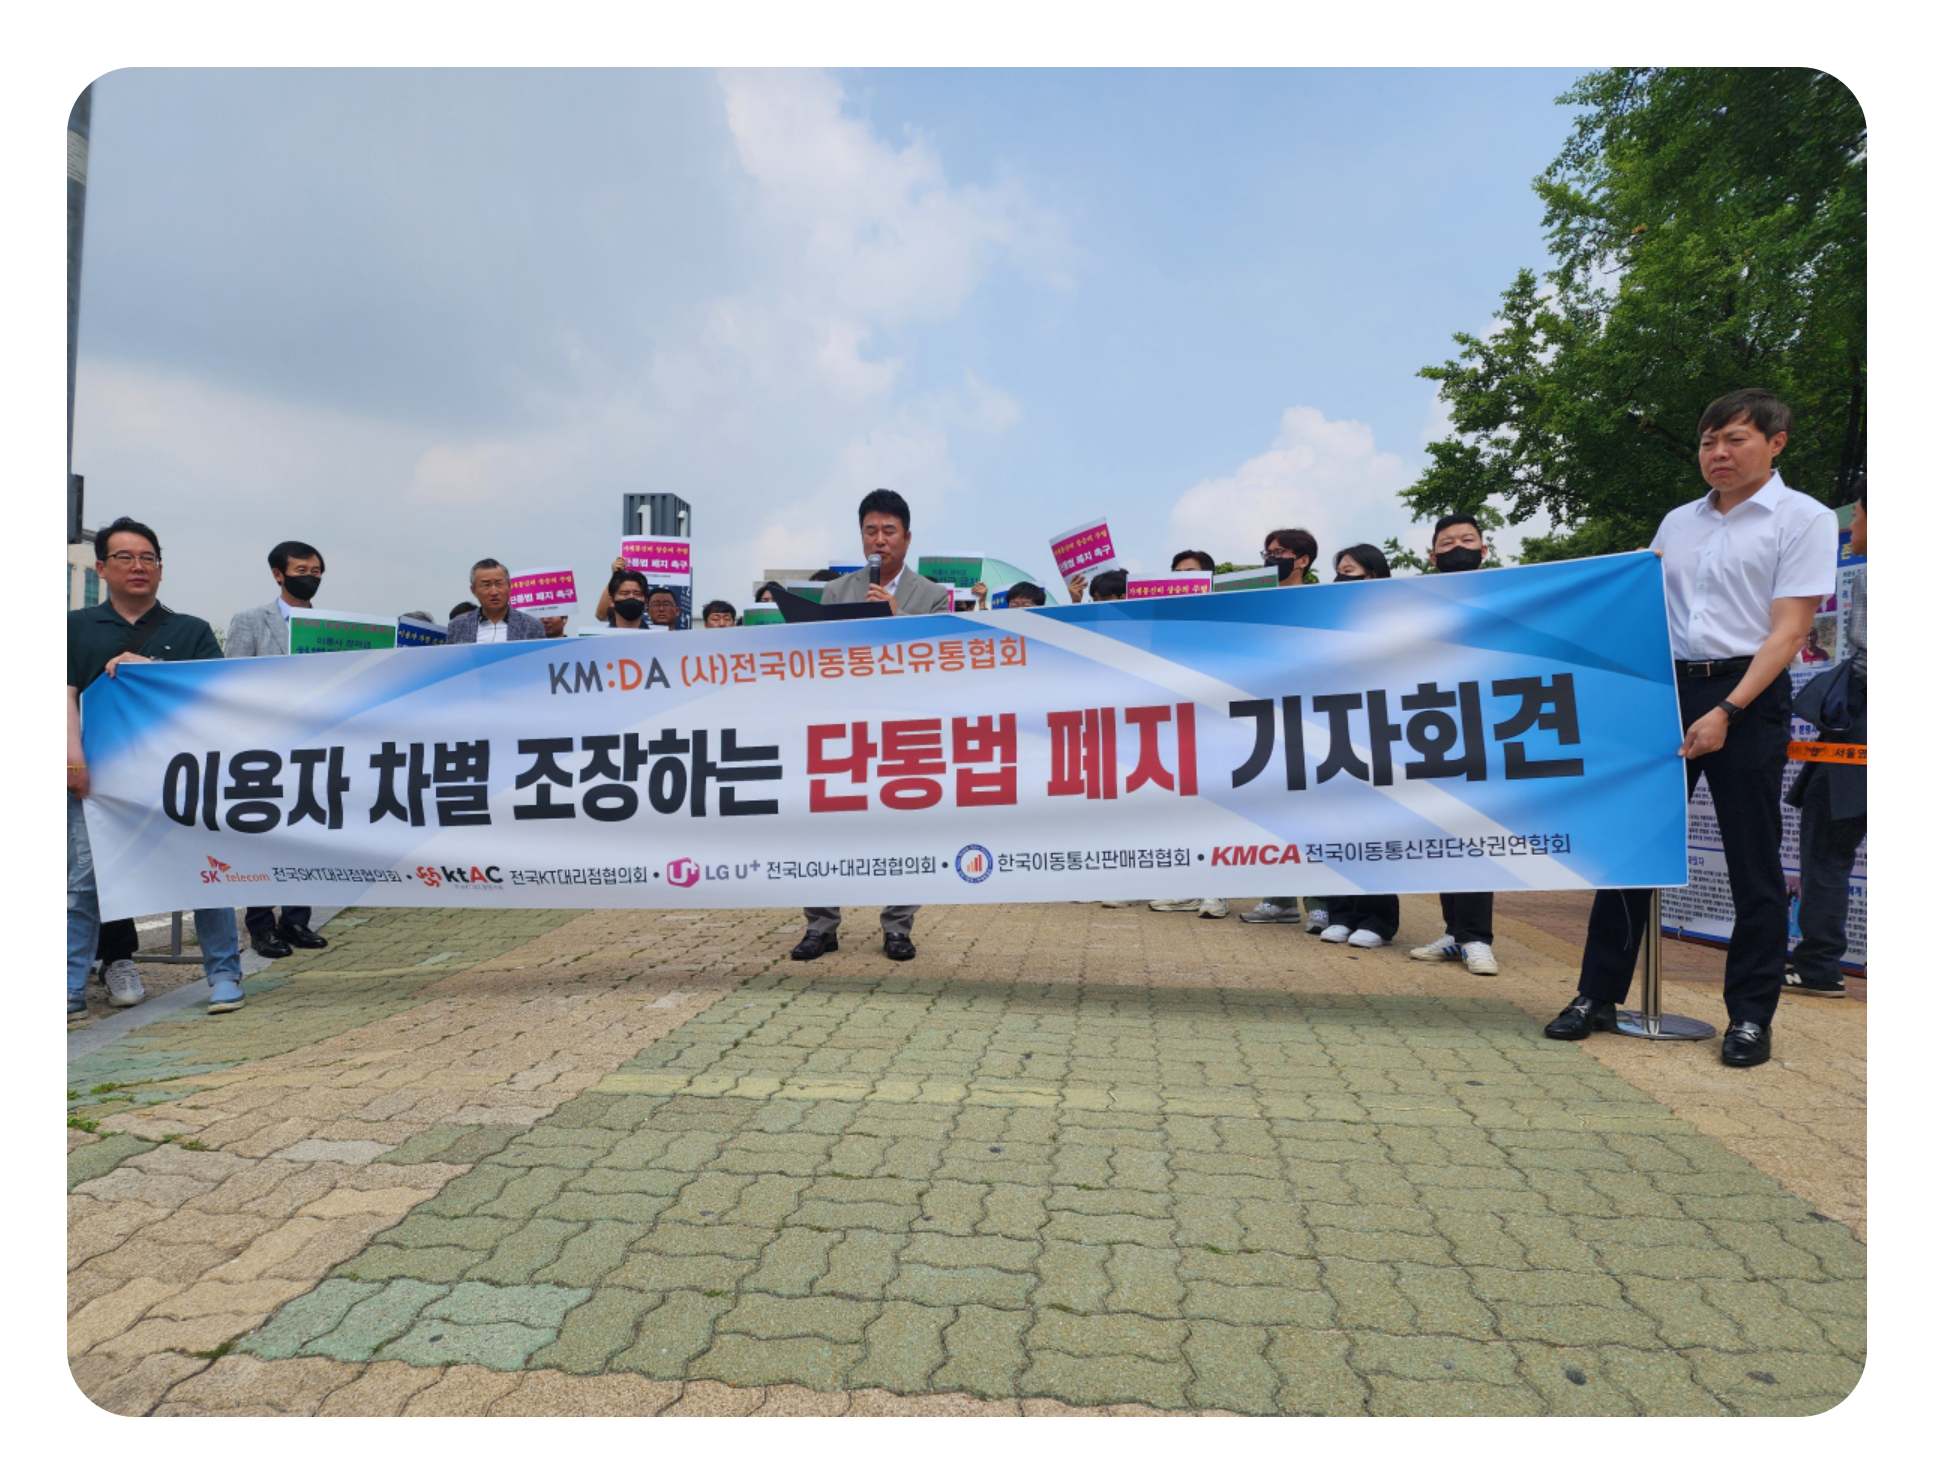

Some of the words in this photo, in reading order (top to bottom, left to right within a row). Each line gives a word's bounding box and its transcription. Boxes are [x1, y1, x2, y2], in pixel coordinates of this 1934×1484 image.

[681, 635, 1028, 687] (사)전국이동통신유통협회
[162, 746, 350, 834] 이용자
[369, 739, 492, 827] 차별
[513, 728, 783, 822] 조장하는
[806, 713, 1018, 813] 단통법
[1047, 702, 1199, 800] 폐지
[1229, 673, 1585, 791] 기자회견
[200, 870, 220, 884] SK
[226, 872, 270, 882] telecom
[272, 867, 402, 883] 전국SKT대리점협의회
[509, 866, 647, 886] 전국KT대리점협의회
[705, 865, 729, 881] LG
[767, 855, 936, 880] 전국LGU+대리점협의회
[997, 848, 1190, 872] 한국이동통신판매점협회
[1210, 844, 1302, 867] KMCA
[1305, 833, 1571, 864] 전국이동통신집단상권연합회
